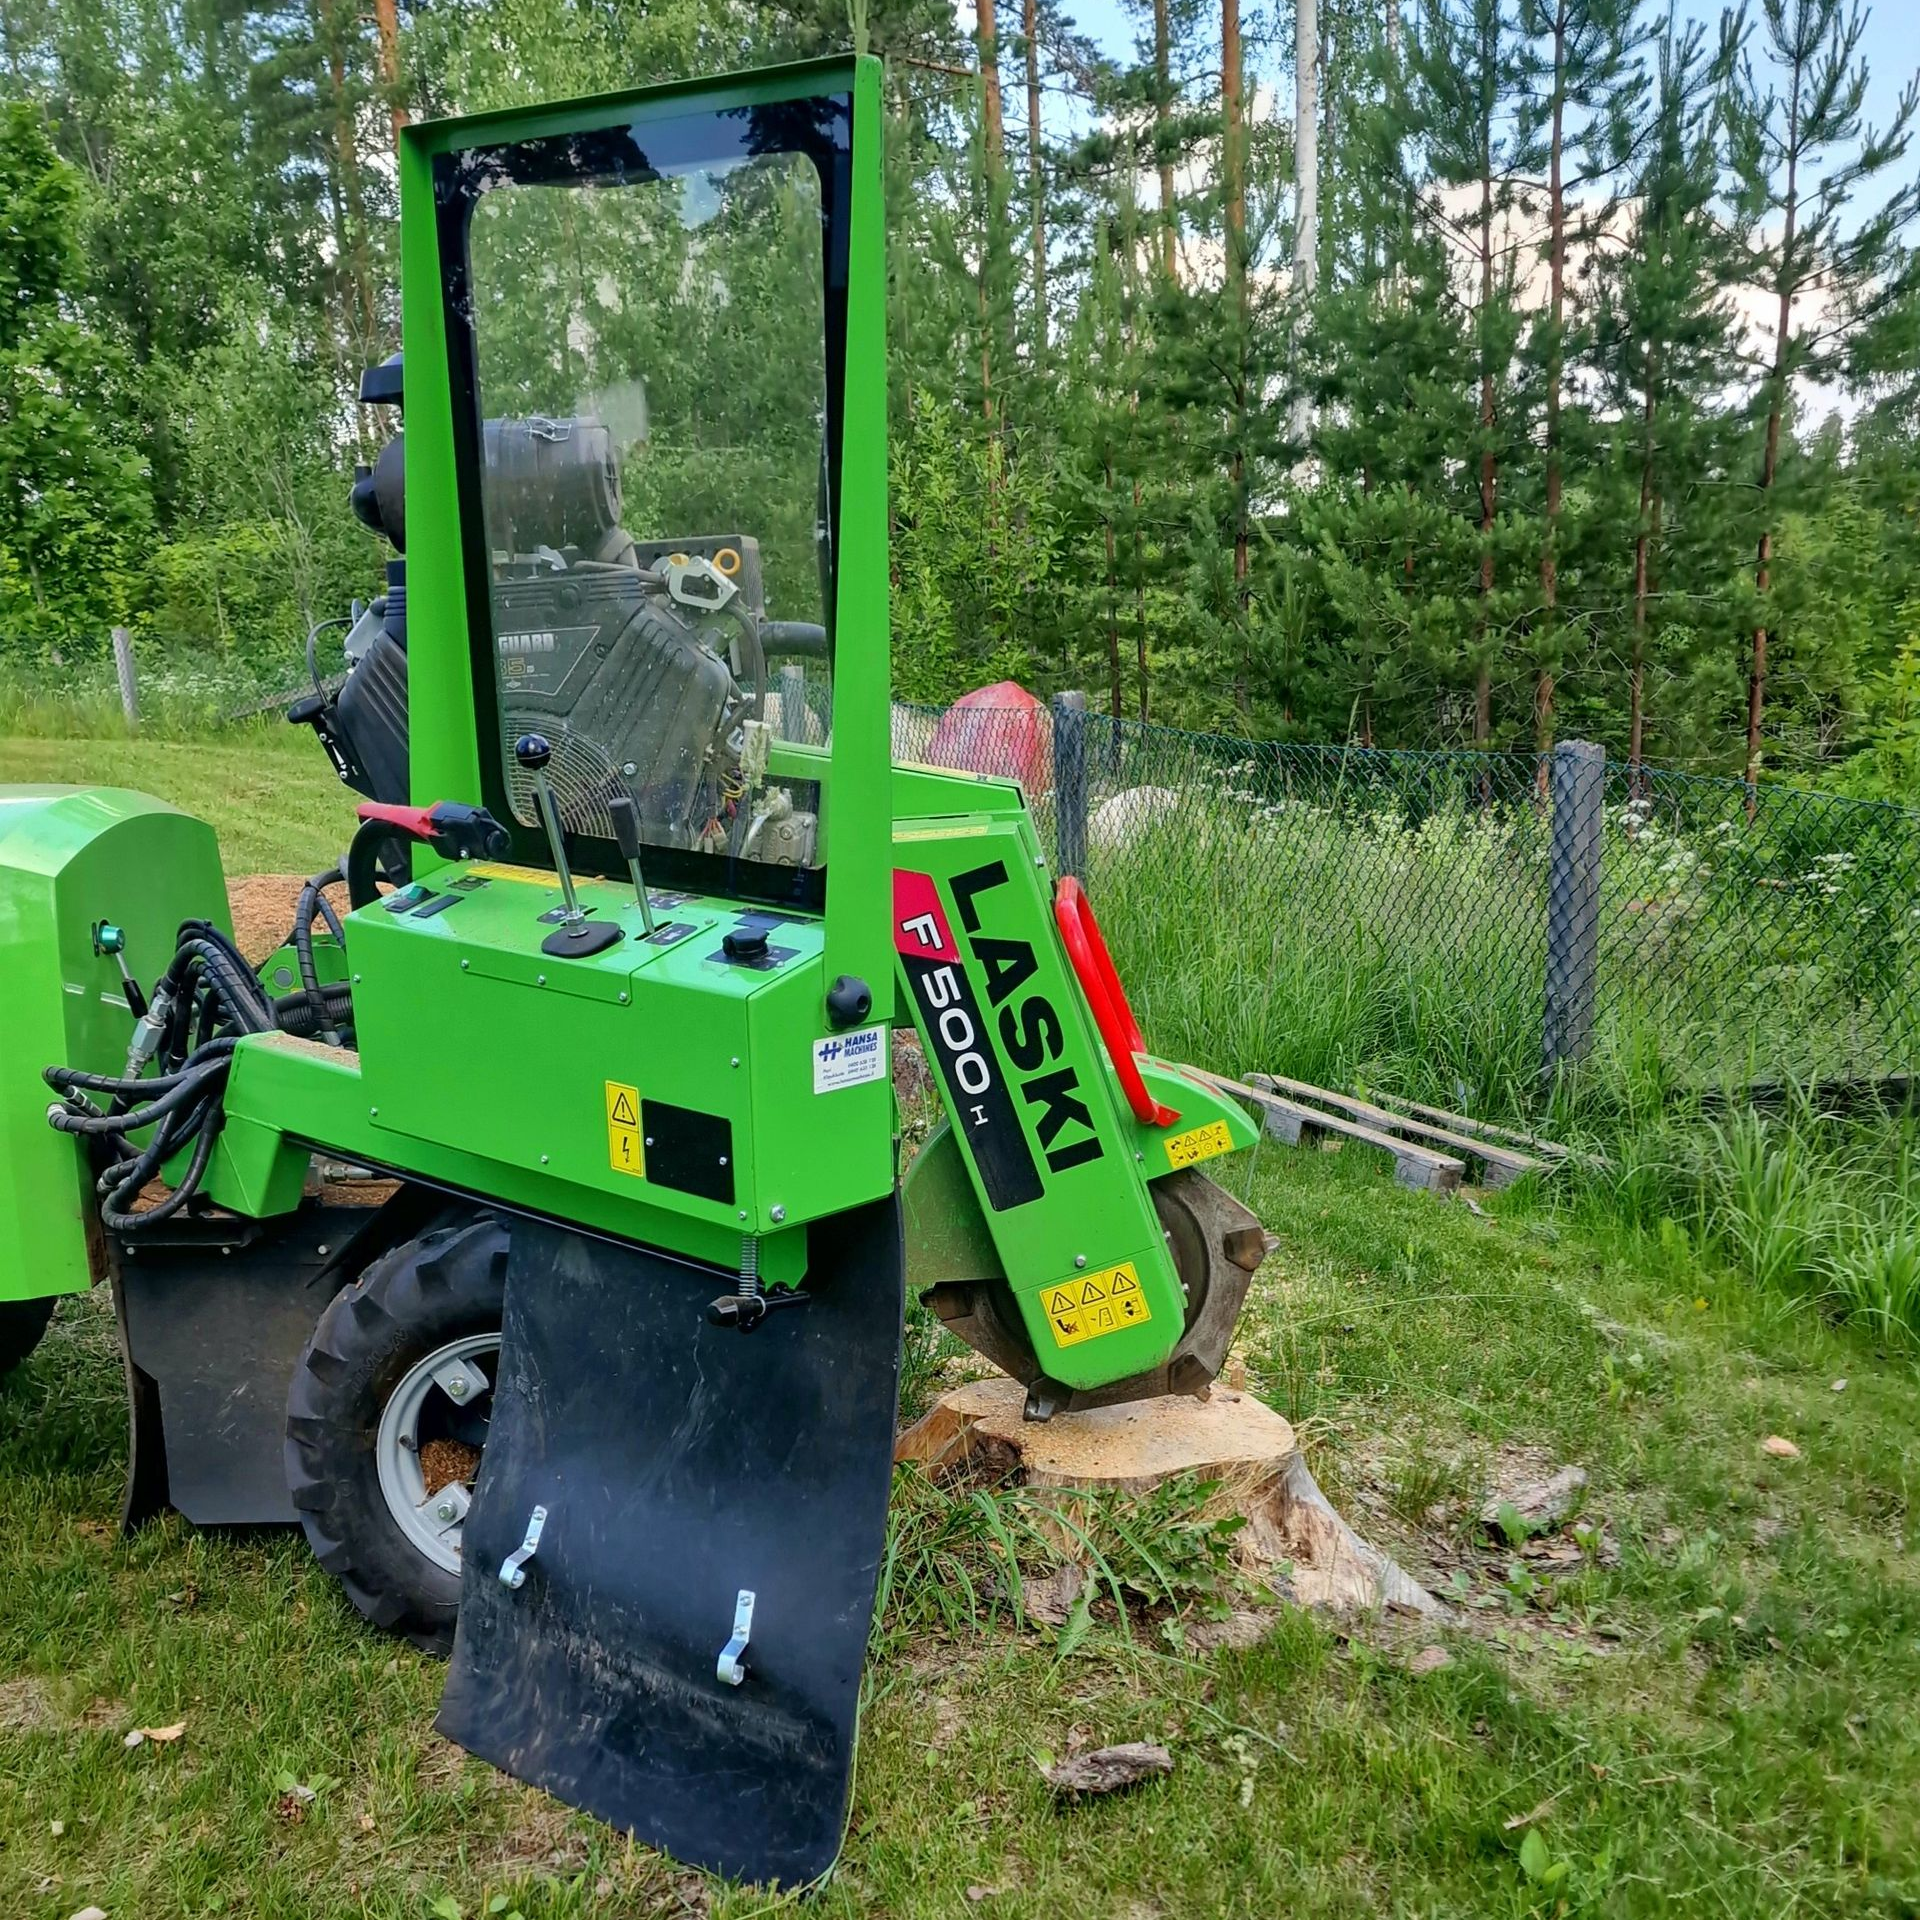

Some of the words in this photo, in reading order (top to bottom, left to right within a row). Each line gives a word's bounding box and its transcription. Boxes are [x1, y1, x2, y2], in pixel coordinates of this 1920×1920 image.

[902, 913, 943, 951] F
[921, 966, 991, 1095] 500
[948, 860, 1104, 1174] LASKI
[844, 1042, 878, 1058] MACHINES
[845, 1032, 878, 1048] HANSA
[970, 1104, 989, 1126] H
